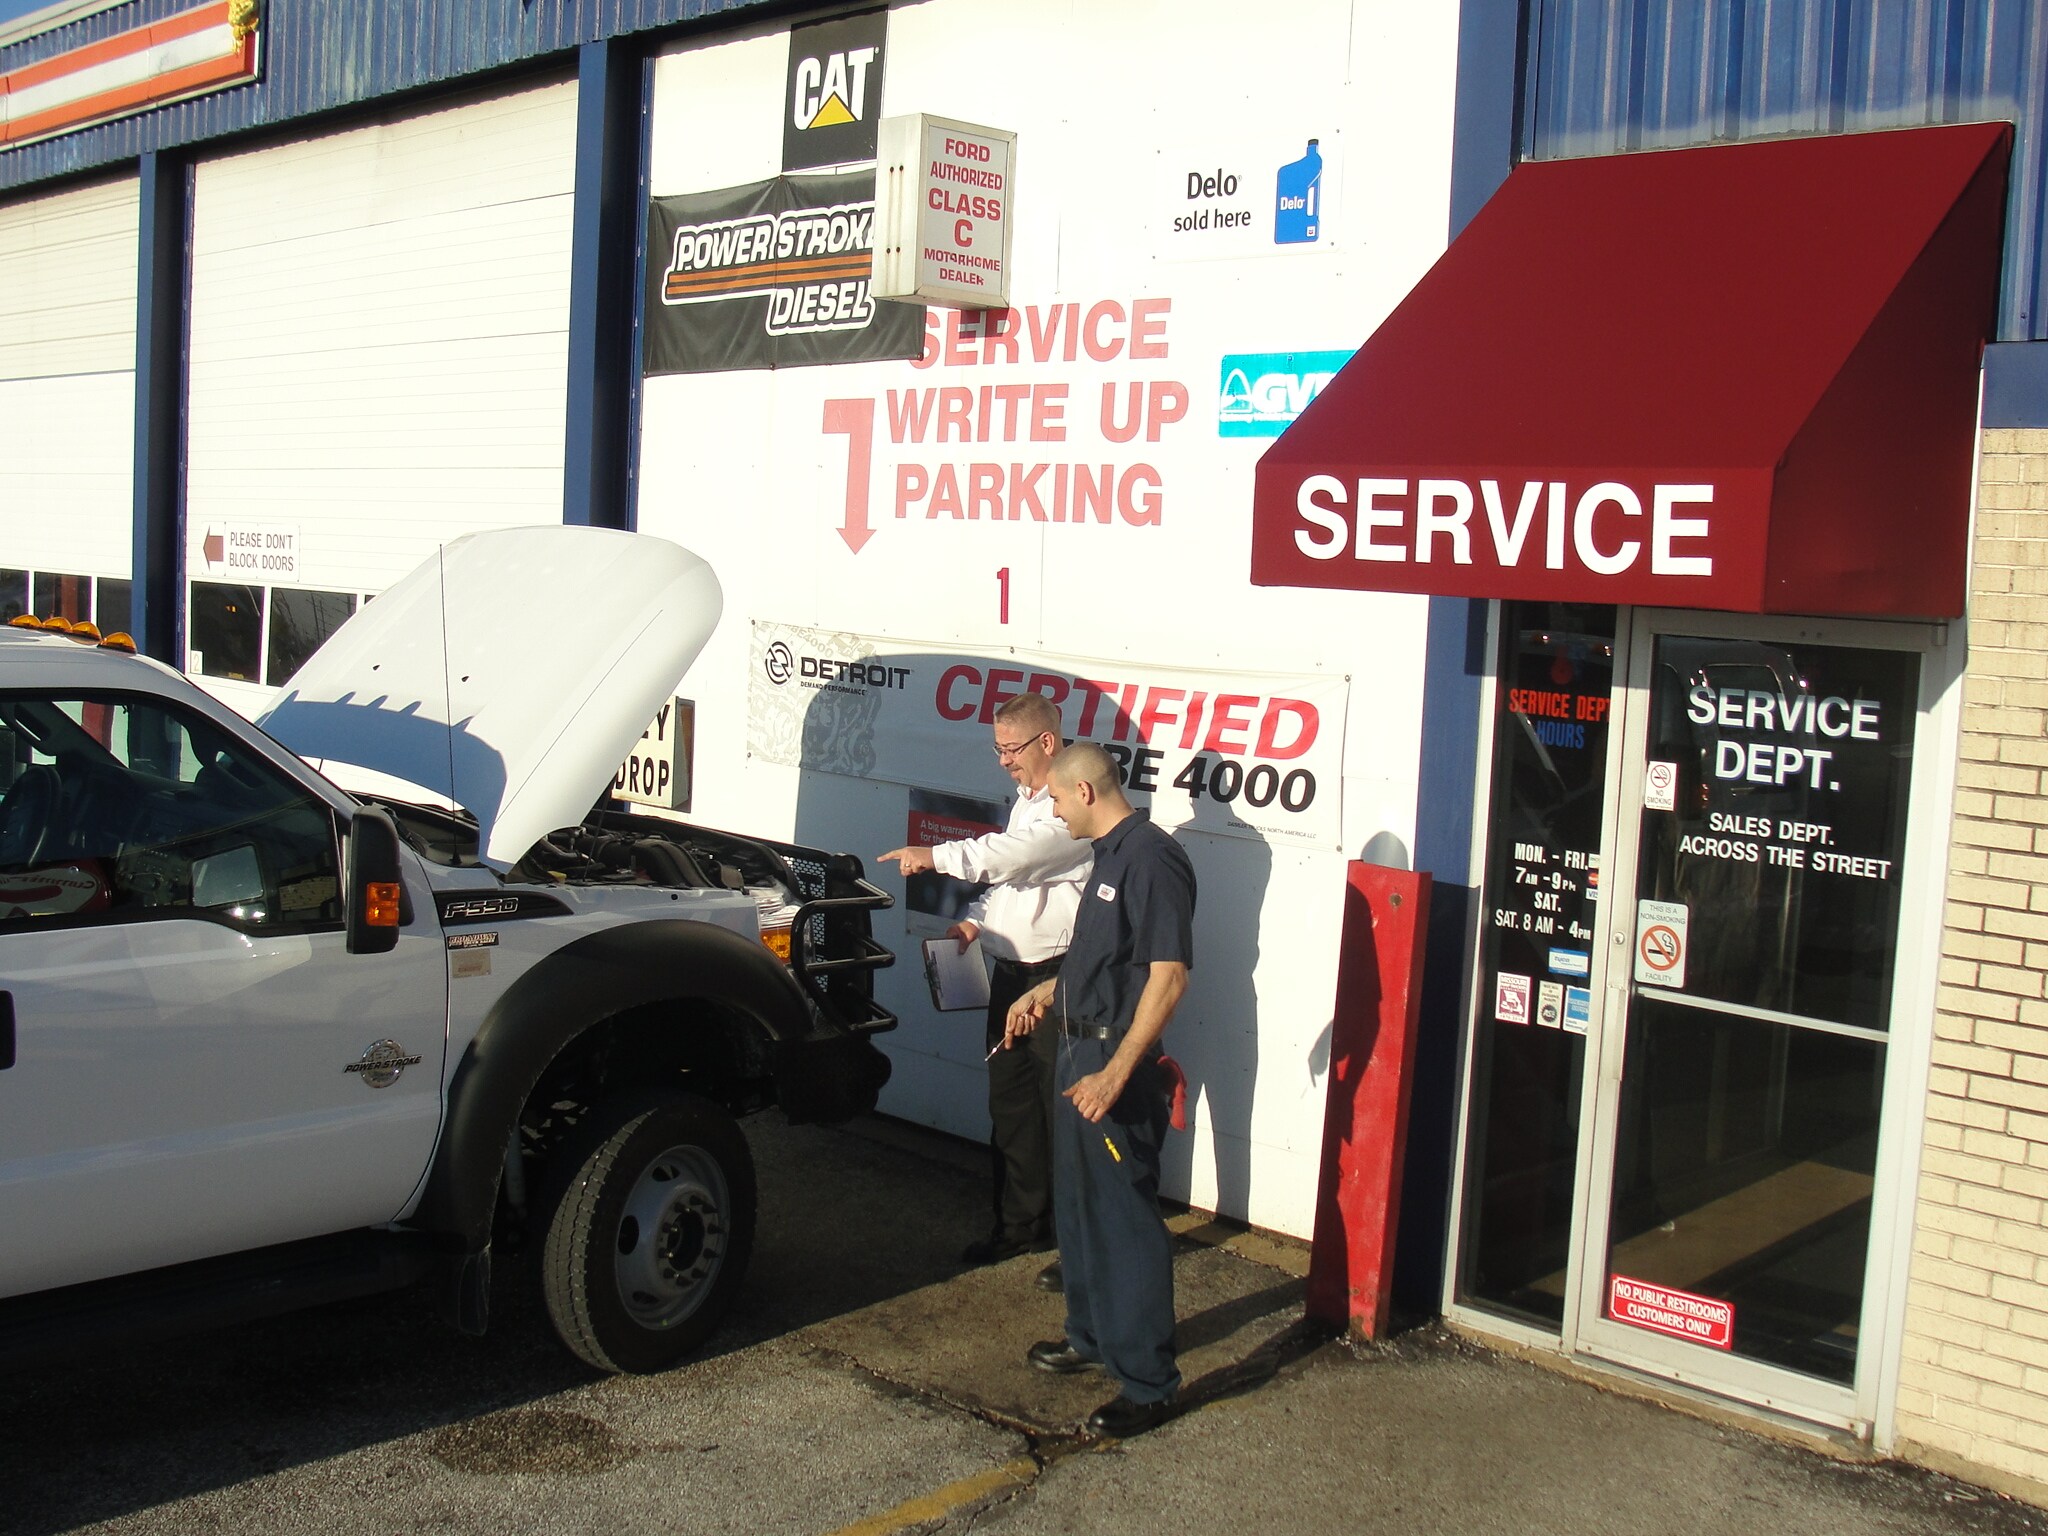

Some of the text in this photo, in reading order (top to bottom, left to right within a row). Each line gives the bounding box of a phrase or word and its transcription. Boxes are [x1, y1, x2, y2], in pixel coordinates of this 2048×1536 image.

[794, 46, 876, 130] CAT
[945, 137, 991, 163] FORD
[930, 160, 1003, 191] AUTHORIZED
[1187, 168, 1238, 199] Delo
[928, 187, 1001, 221] CLASS
[1279, 196, 1305, 211] Delo
[954, 218, 973, 248] C
[1174, 208, 1251, 232] sold here
[677, 224, 775, 271] POWER
[924, 248, 1001, 272] MOTORHOME
[939, 267, 985, 286] DEALER
[771, 281, 869, 326] DIESEL
[909, 297, 1173, 369] SERVICE
[886, 380, 1189, 443] WRITE UP
[895, 463, 1162, 527] PARKING
[230, 531, 294, 550] PLEASE DON'T
[1293, 474, 1715, 577] SERVICE
[229, 552, 294, 572] BLOCK DOORS
[996, 566, 1009, 625] 1
[193, 654, 200, 672] 2
[800, 656, 911, 690] DETROIT
[800, 681, 866, 696] DEMAND PERFORMANCE
[1508, 688, 1571, 719] SERVICE
[935, 664, 1320, 760] CERTIFIED
[1687, 685, 1881, 740] SERVICE
[1536, 720, 1585, 750] HOURS
[1715, 740, 1840, 791] DEPT.
[1172, 756, 1317, 813] 4000
[1655, 789, 1664, 797] NO
[1646, 796, 1672, 806] SMOKING
[927, 821, 940, 833] big
[940, 825, 977, 837] warranty
[1709, 812, 1835, 846] SALES DEPT.
[1514, 842, 1547, 864] MON.
[1564, 849, 1589, 871] FRI.
[1679, 835, 1891, 880] ACROSS THE STREET
[1534, 891, 1562, 912] SAT.
[1649, 904, 1662, 913] THIS
[1495, 908, 1519, 929] SAT.
[1523, 913, 1531, 931] 8
[1535, 915, 1553, 935] AM
[1640, 912, 1686, 925] NON-SMOKING
[1645, 972, 1673, 982] FACILITY
[344, 1055, 423, 1073] POWER STROKE
[1615, 1282, 1727, 1322] NO PUBLIC RESTROOMS
[1627, 1303, 1712, 1336] CUSTOMERS ONLY
